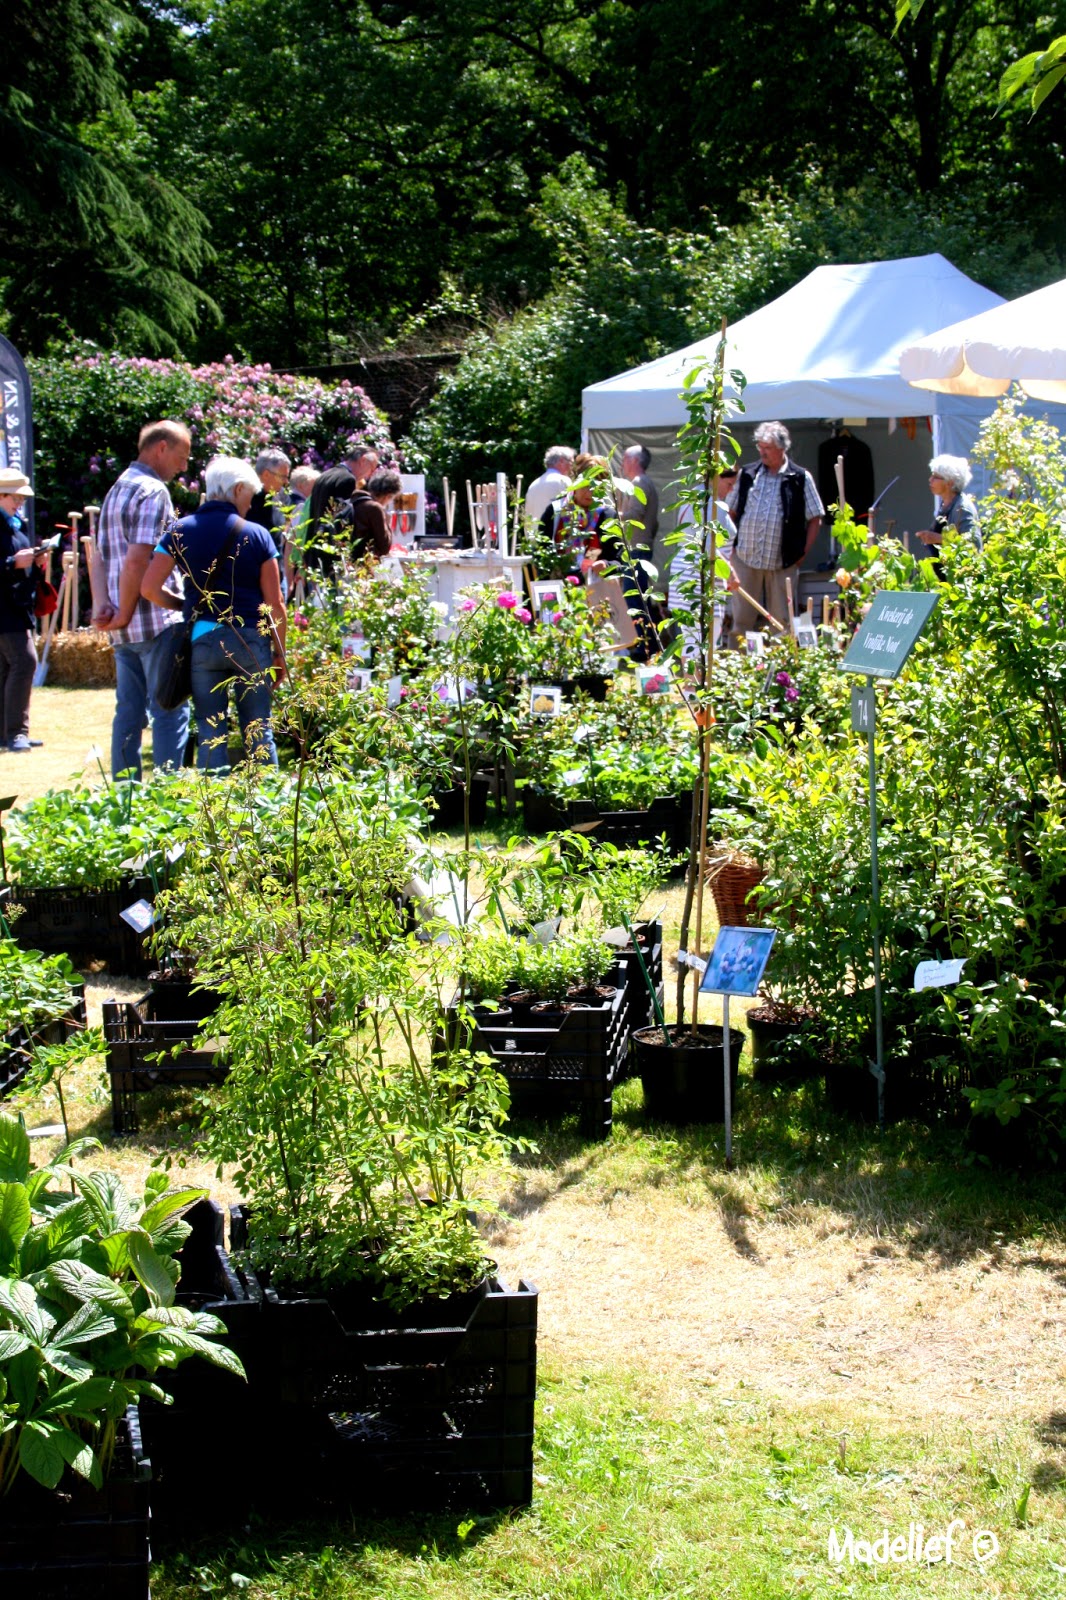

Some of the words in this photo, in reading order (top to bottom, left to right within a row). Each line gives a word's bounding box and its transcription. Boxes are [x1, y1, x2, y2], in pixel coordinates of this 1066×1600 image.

[878, 605, 909, 628] Kwekerij
[902, 608, 914, 625] de
[882, 635, 901, 653] Noot
[857, 699, 869, 727] 74
